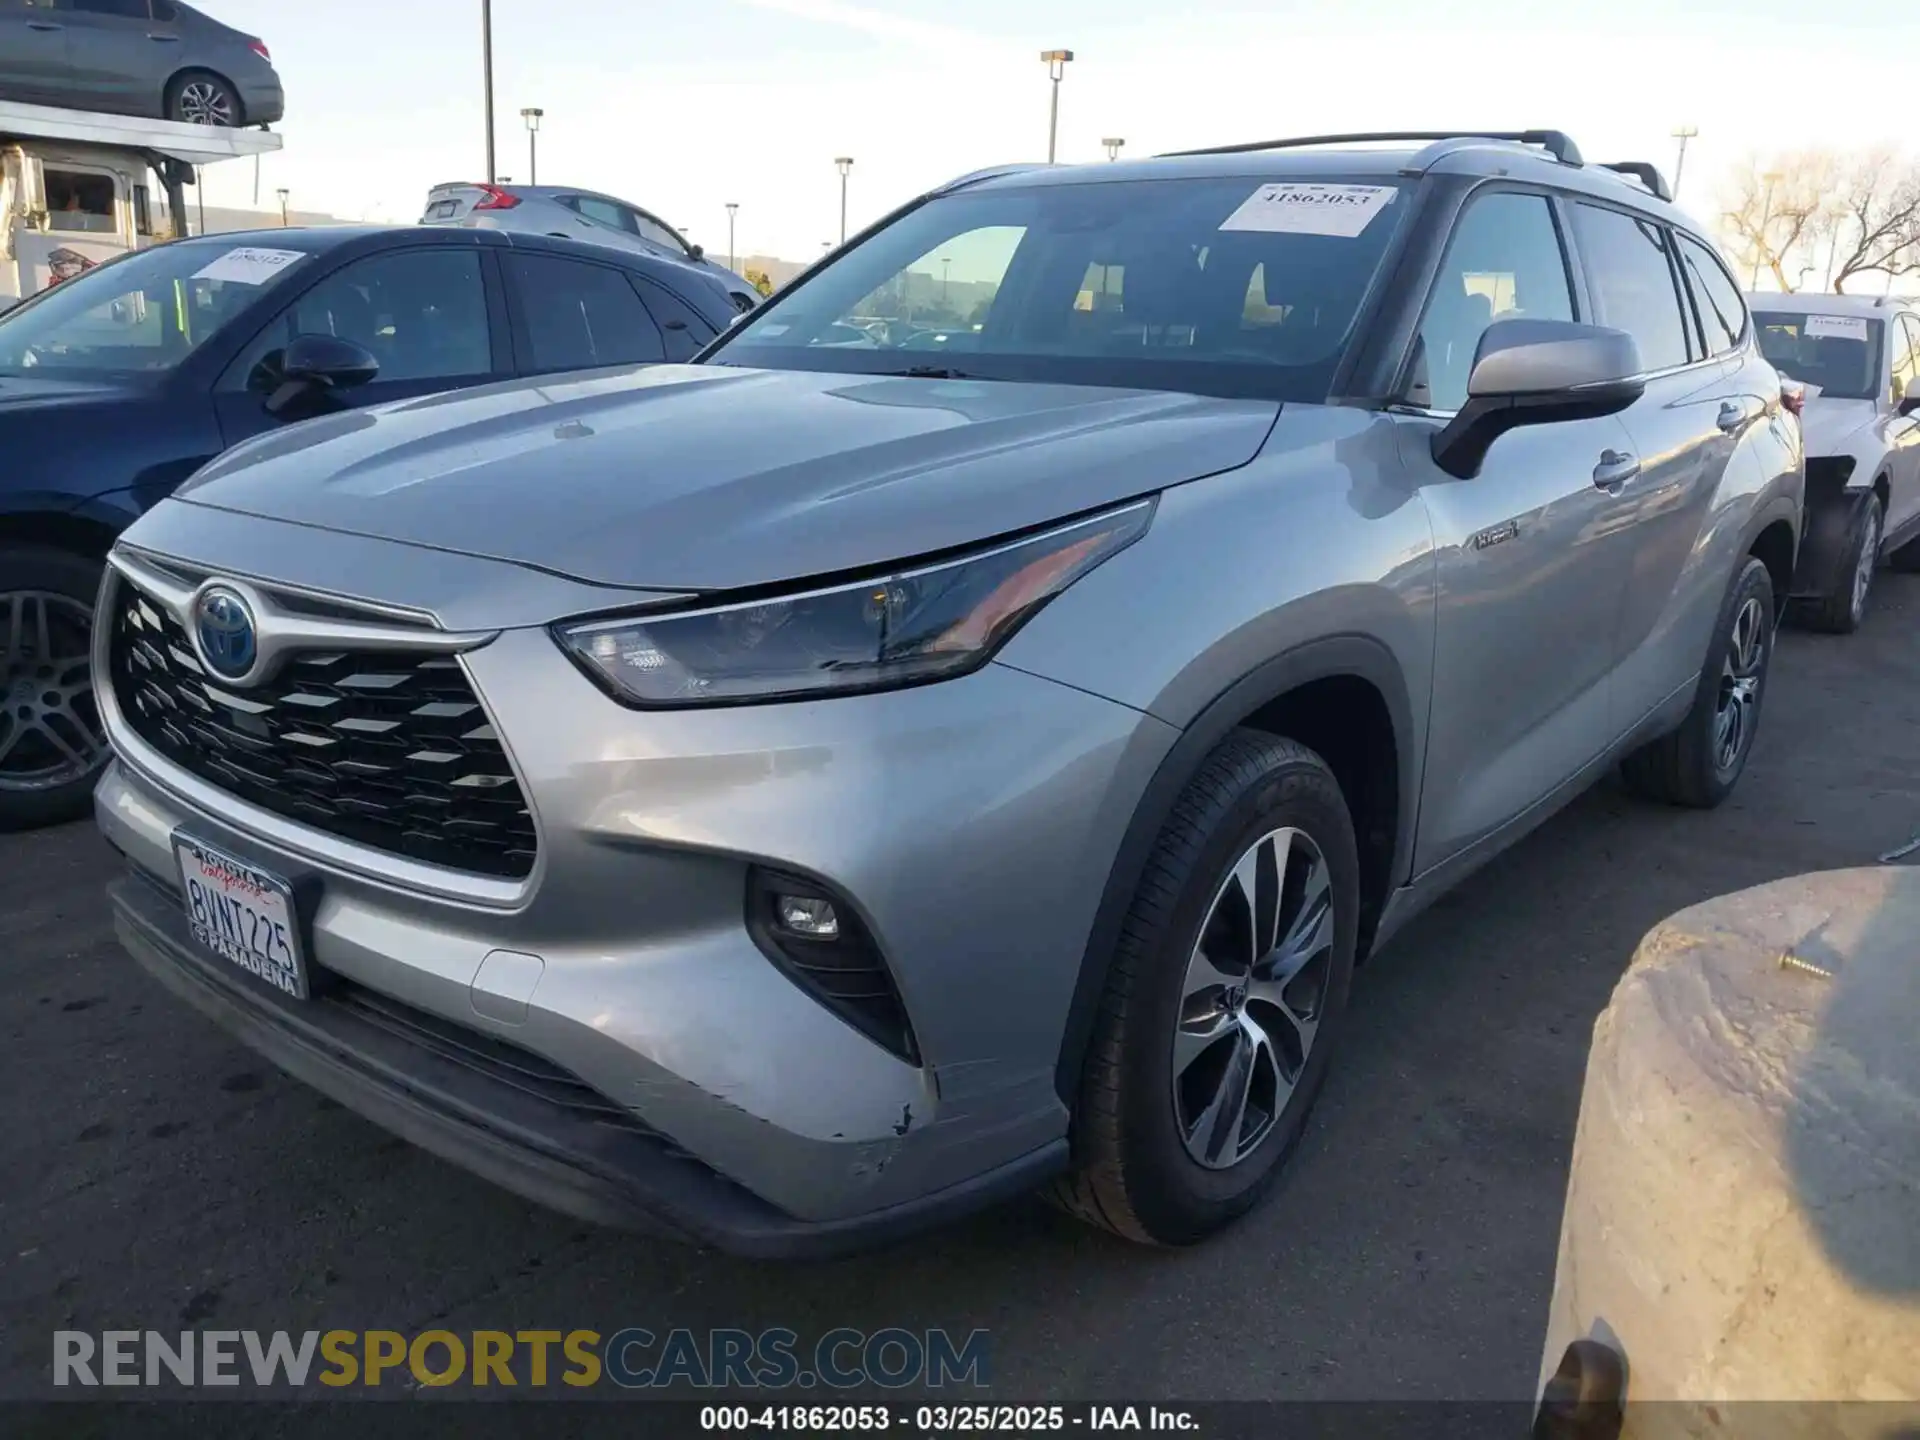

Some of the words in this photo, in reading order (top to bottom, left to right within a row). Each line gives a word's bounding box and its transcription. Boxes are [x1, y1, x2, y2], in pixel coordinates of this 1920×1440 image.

[201, 850, 262, 886] TOYOTA
[190, 878, 294, 971] 8VNT225
[206, 928, 297, 995] PASADENA
